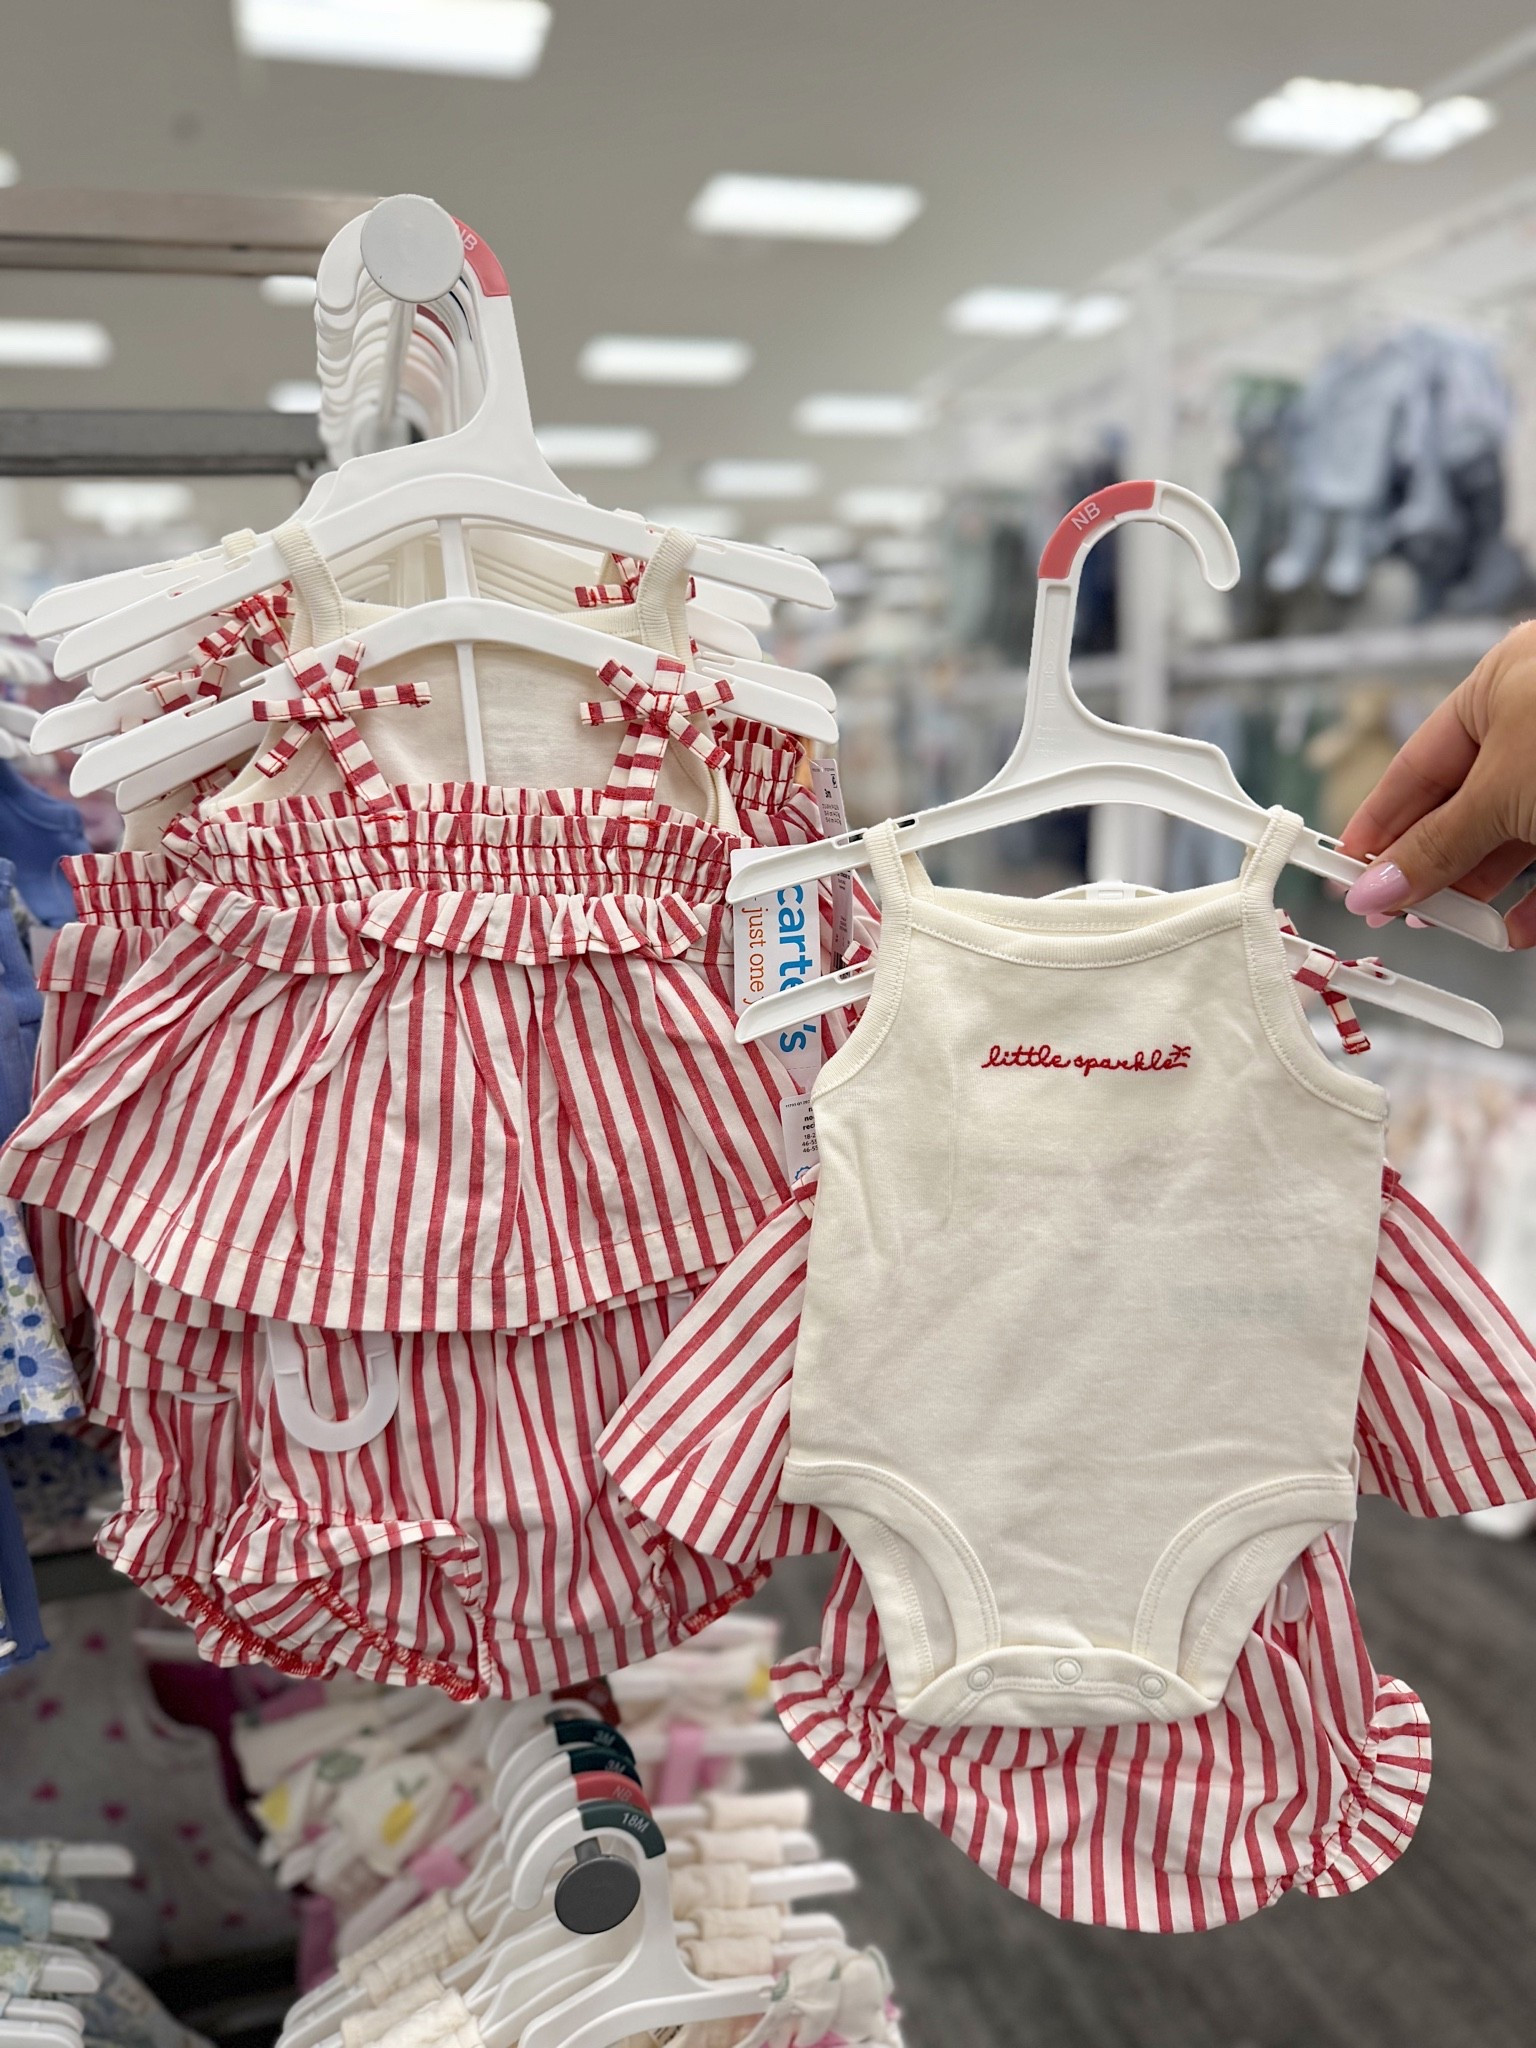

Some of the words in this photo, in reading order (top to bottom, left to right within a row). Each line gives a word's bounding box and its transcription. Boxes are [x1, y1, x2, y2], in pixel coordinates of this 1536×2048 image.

[1071, 502, 1101, 531] NB
[742, 907, 768, 948] just
[749, 954, 765, 992] one
[981, 1044, 1069, 1068] little
[1074, 1049, 1187, 1077] sparkle
[594, 1731, 615, 1746] 3M
[612, 1785, 632, 1801] NB
[622, 1812, 649, 1833] 18M
